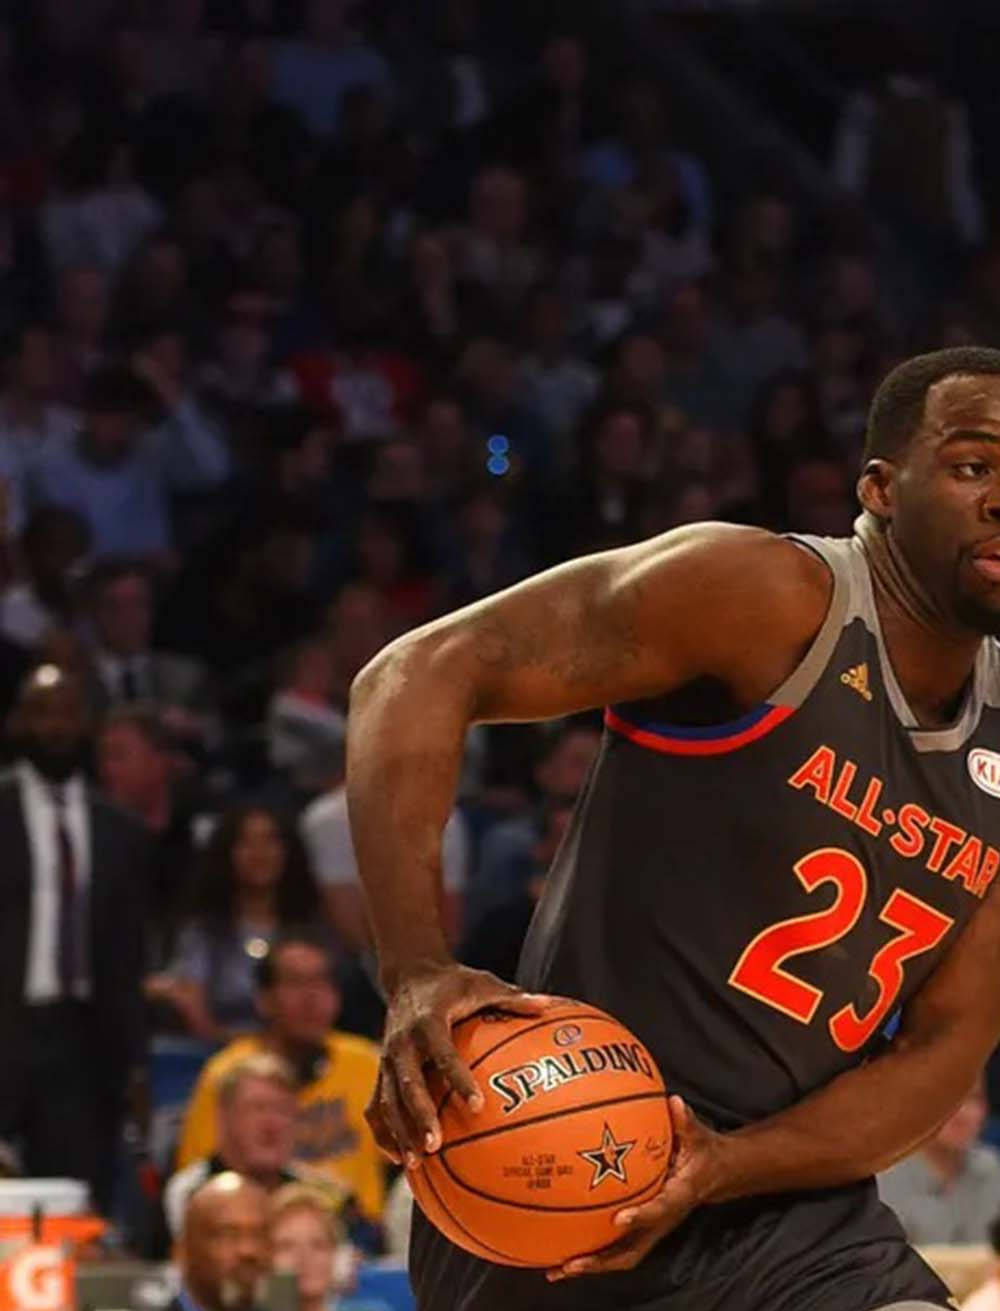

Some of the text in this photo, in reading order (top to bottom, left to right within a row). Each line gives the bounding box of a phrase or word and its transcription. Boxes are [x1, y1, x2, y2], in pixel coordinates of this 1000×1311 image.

[728, 846, 955, 1052] 23
[490, 1042, 654, 1114] SPALDING
[10, 1247, 66, 1311] G
